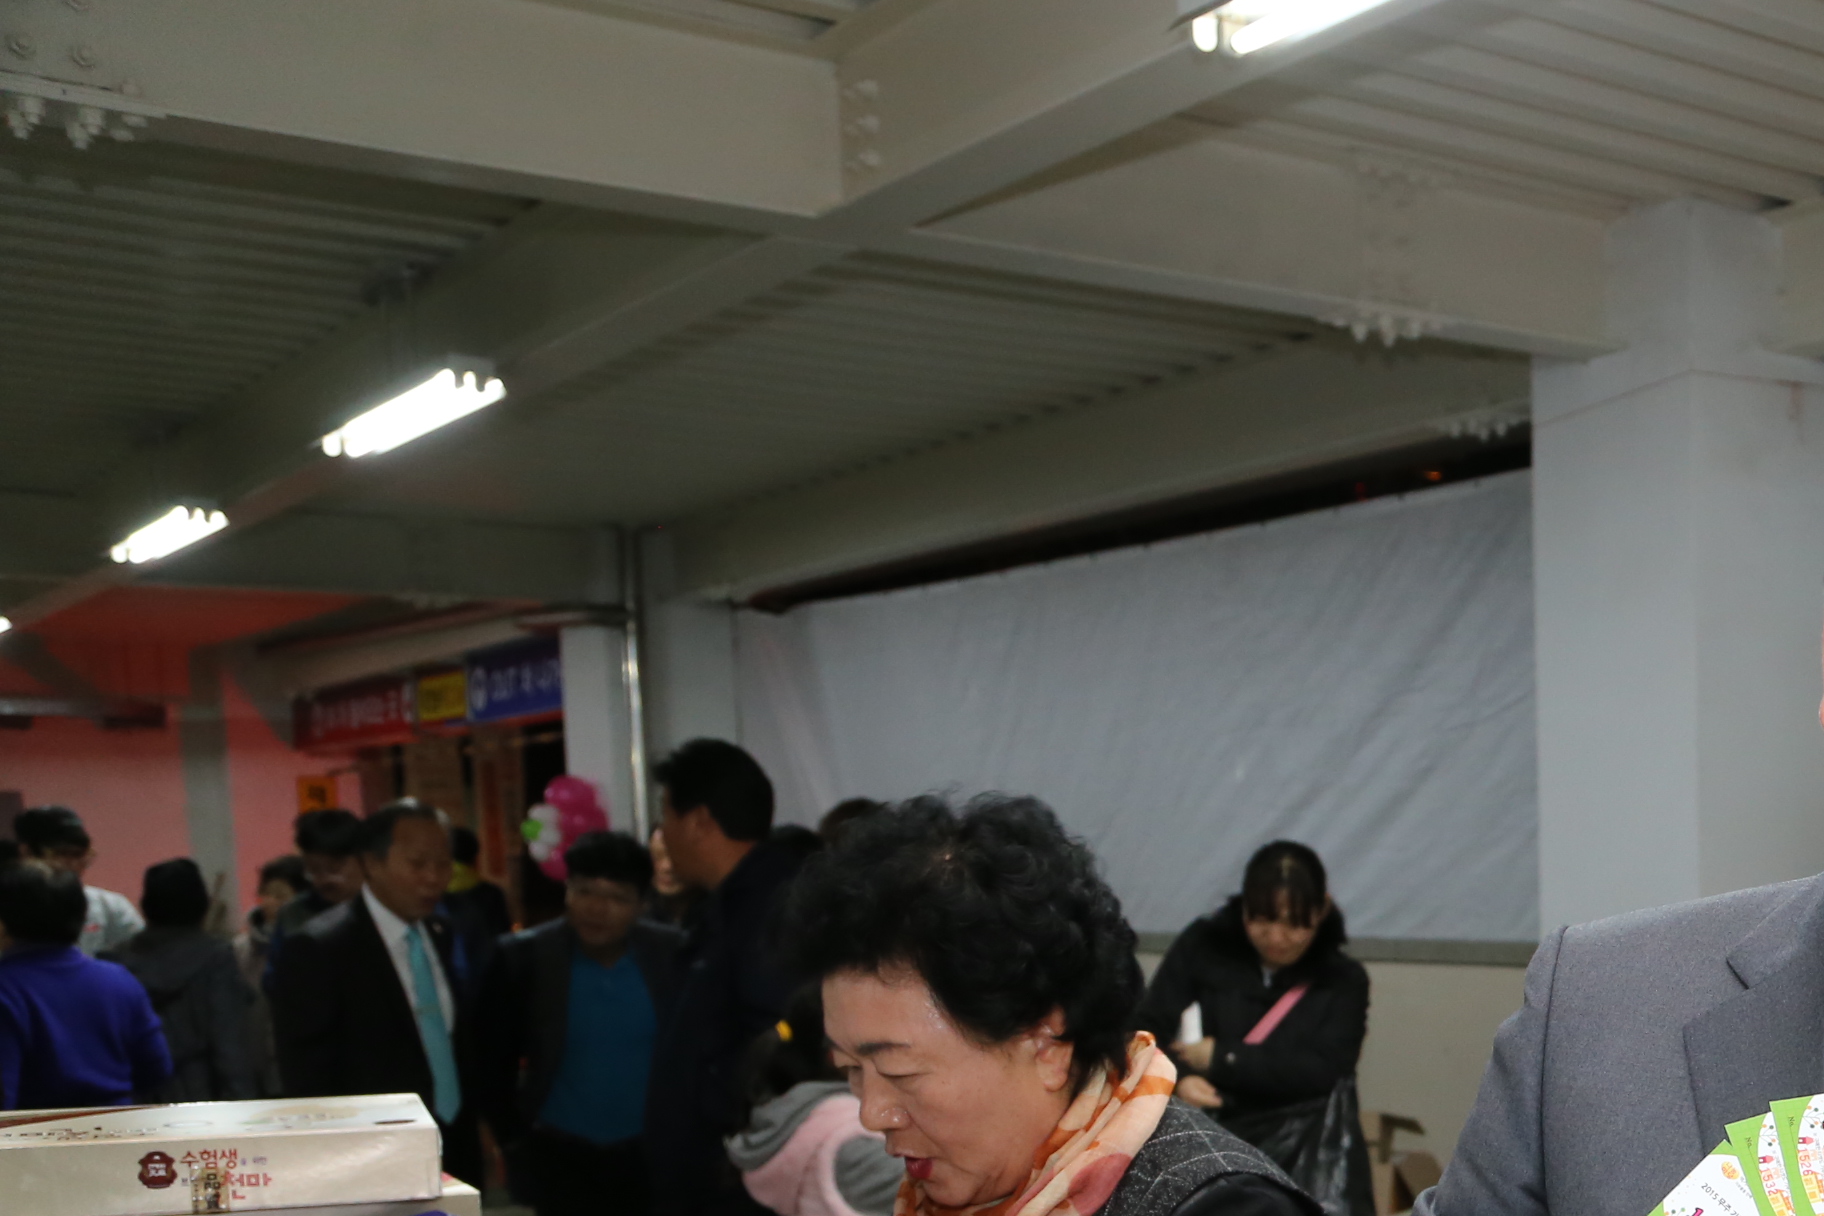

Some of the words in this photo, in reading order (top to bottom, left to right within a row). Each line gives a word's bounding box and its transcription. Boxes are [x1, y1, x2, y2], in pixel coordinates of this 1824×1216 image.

[1745, 1136, 1753, 1148] No.
[1760, 1167, 1777, 1196] 1532
[1787, 1116, 1795, 1126] No.
[1797, 1147, 1813, 1176] 1526
[1700, 1181, 1719, 1200] 2015
[1716, 1196, 1732, 1212] 무주
